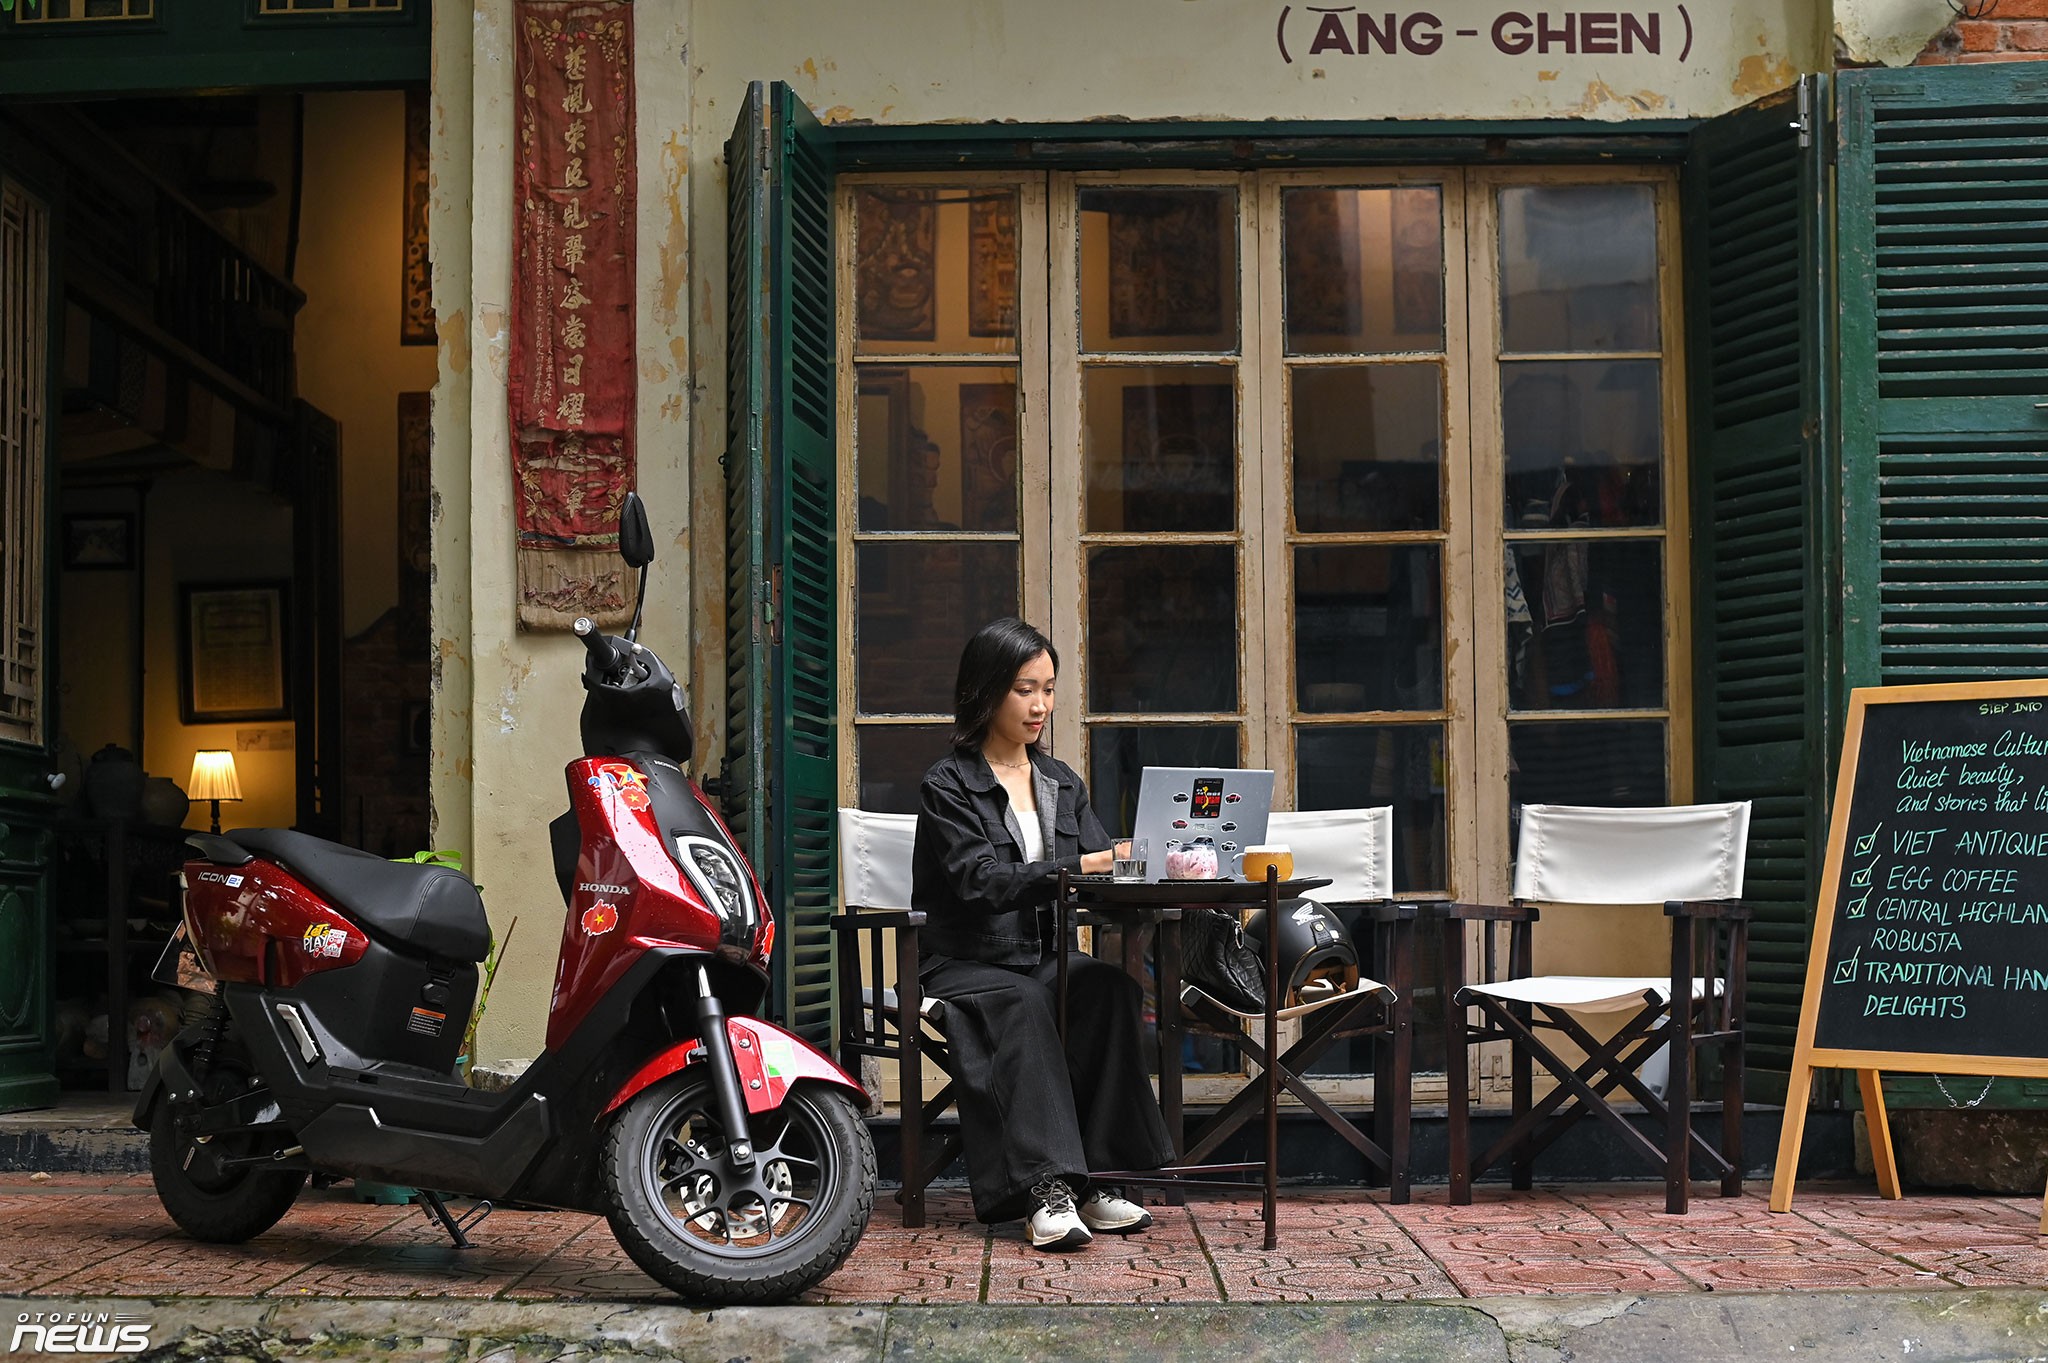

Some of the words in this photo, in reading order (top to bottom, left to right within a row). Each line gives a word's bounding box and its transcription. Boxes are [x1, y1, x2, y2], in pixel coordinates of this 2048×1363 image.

[2012, 702, 2043, 714] INTO
[1902, 739, 1988, 764] Vietnamese
[1896, 765, 1950, 790] Quiet
[1958, 761, 2025, 792] beauty,
[1934, 792, 1988, 812] stories
[1994, 790, 2028, 812] that
[1893, 828, 1948, 856] VIET
[197, 871, 229, 884] ICON
[578, 882, 631, 896] HONDA
[1886, 866, 1934, 891] EGG
[1942, 868, 2018, 893] COFFEE
[1875, 897, 1953, 926] CENTRAL
[303, 934, 329, 953] PLAY
[1870, 927, 1963, 953] ROBUSTA
[1863, 961, 1995, 988] TRADITIONAL
[1863, 994, 1967, 1019] DELIGHTS
